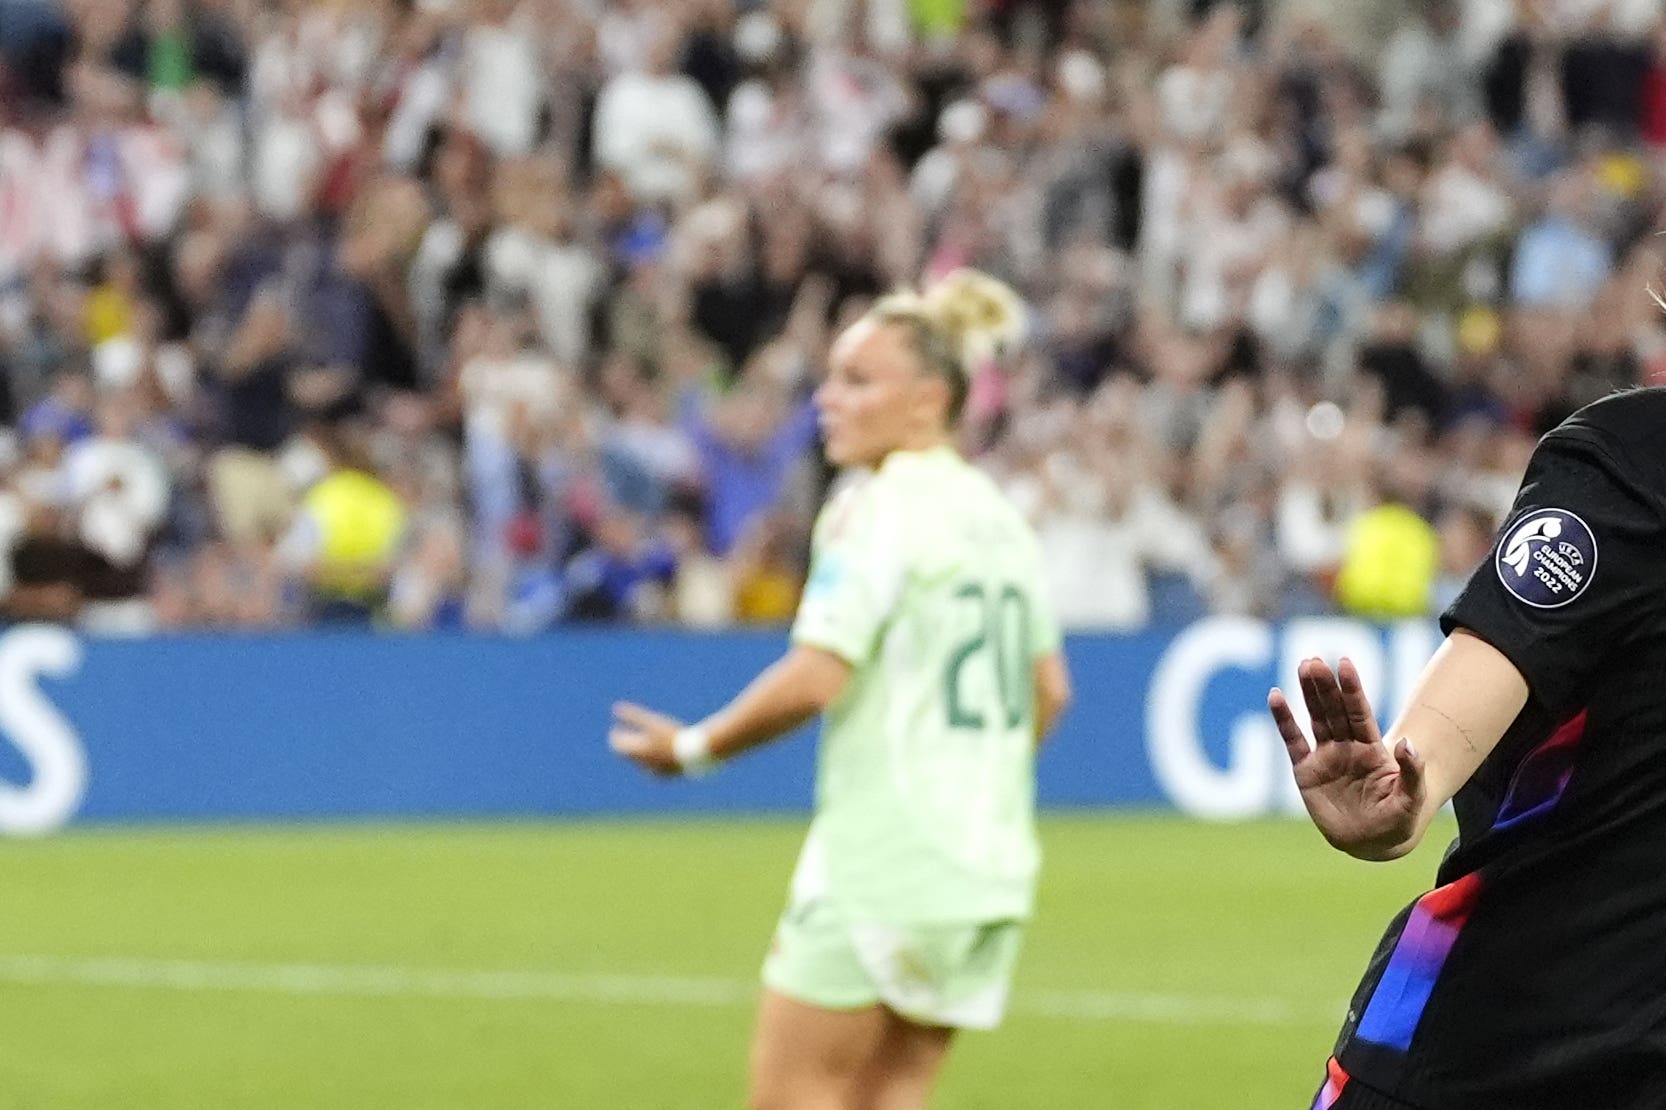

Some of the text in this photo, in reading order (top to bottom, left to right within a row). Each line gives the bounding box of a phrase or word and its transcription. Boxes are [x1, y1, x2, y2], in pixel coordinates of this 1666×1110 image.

[1533, 551, 1578, 592] CHAMPIONS
[1541, 545, 1582, 583] EUROPEAN
[1559, 542, 1583, 565] UEFA
[1533, 567, 1562, 593] 2022
[942, 581, 1031, 730] 20
